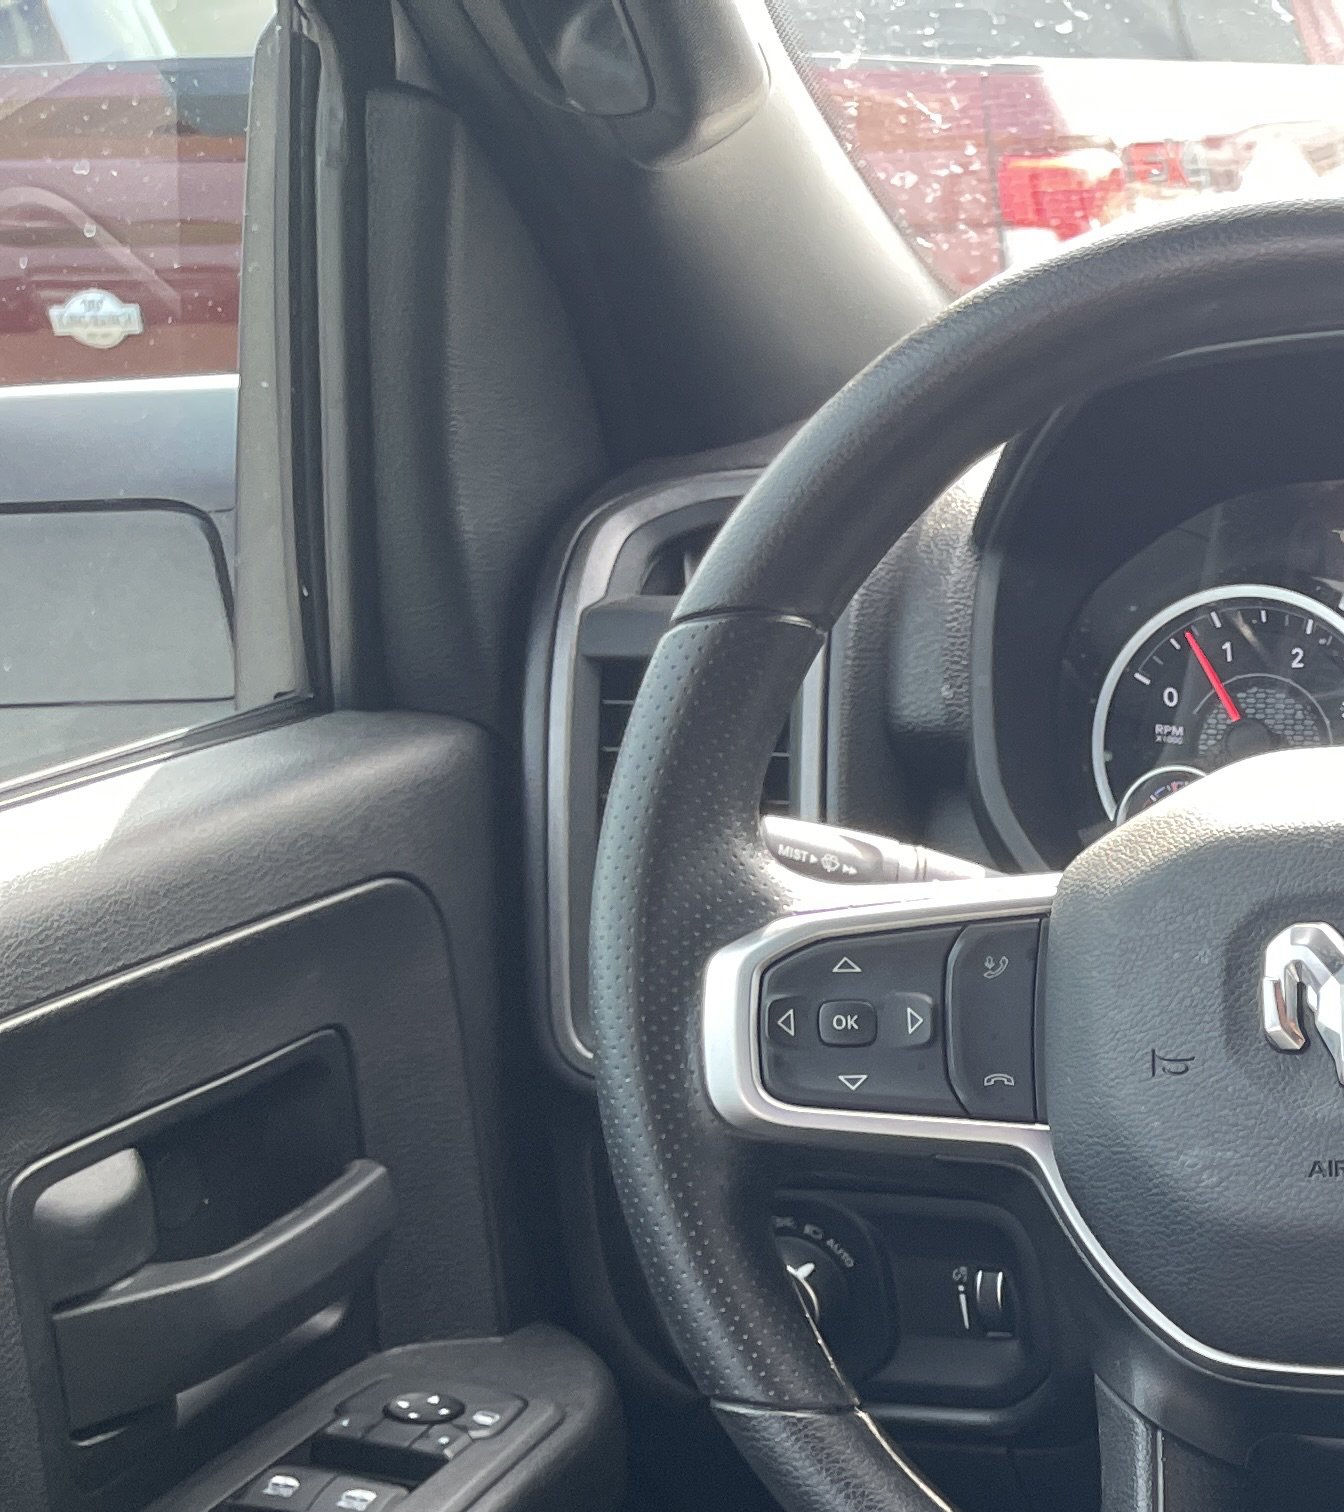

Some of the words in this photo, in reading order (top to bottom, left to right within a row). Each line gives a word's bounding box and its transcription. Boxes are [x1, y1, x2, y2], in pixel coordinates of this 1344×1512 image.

[1222, 641, 1233, 663] 1
[1291, 648, 1304, 668] 2
[1163, 687, 1178, 707] 0
[1154, 723, 1185, 736] RPM
[778, 844, 809, 864] MIST
[832, 1014, 859, 1031] OK
[826, 1238, 854, 1268] AUTO
